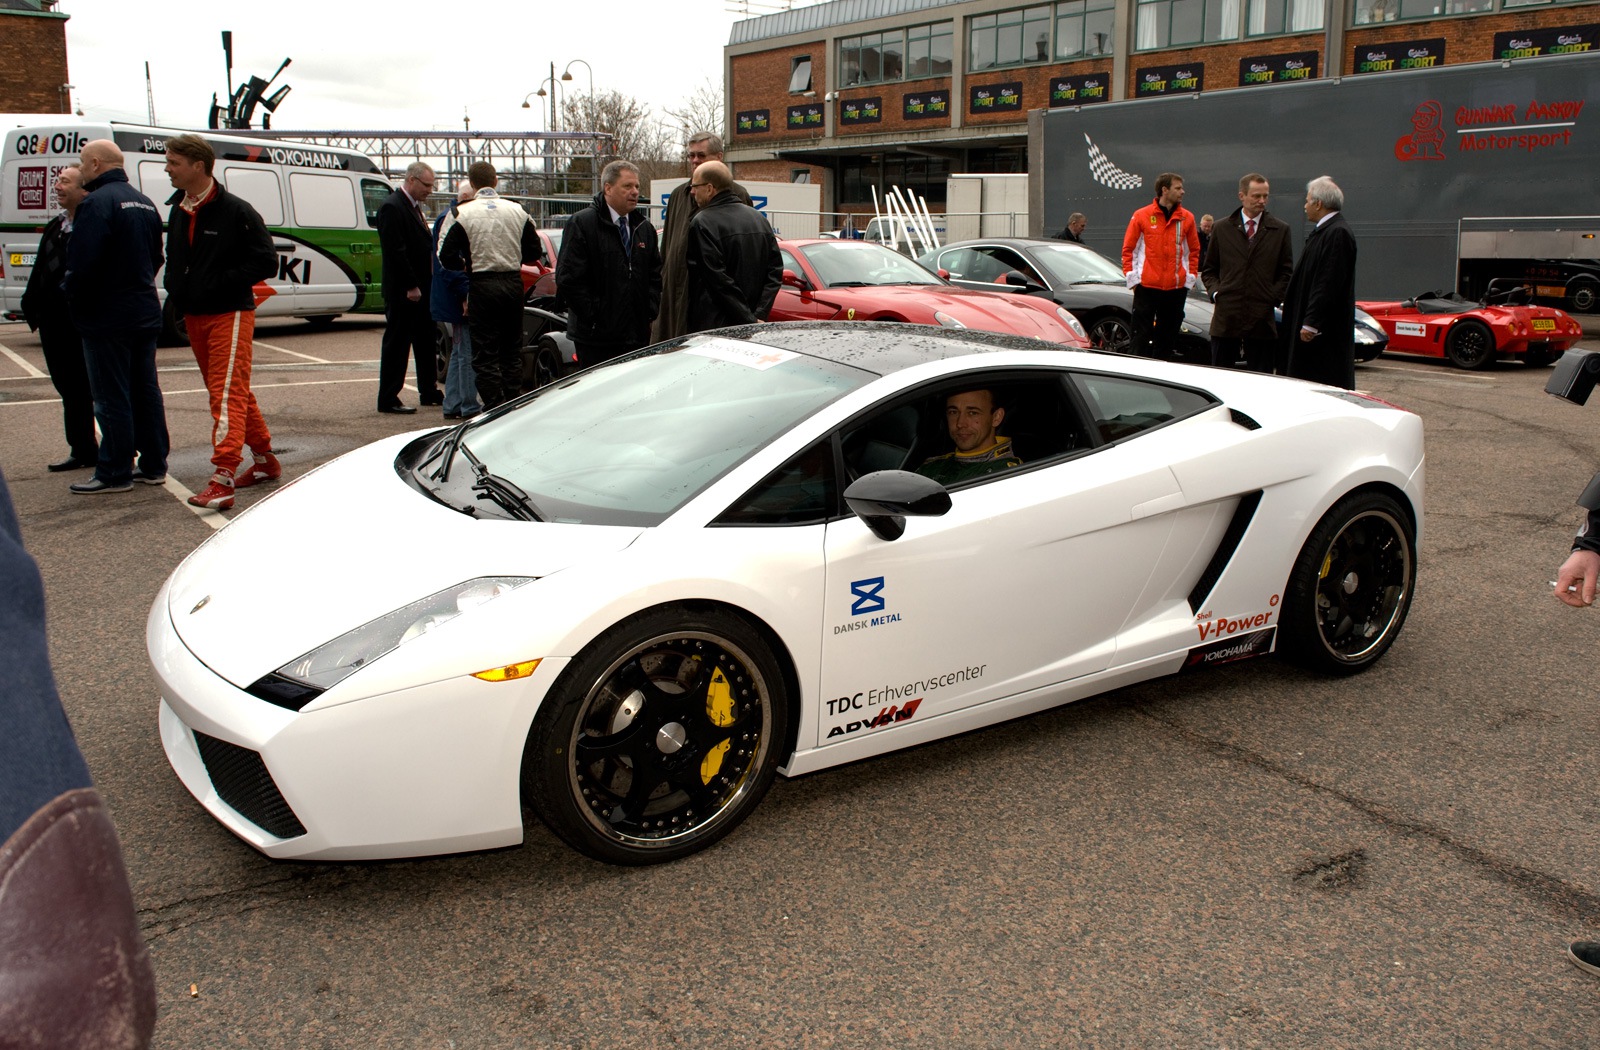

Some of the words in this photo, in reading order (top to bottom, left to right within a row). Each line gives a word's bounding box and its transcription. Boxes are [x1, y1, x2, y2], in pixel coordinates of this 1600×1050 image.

[1360, 60, 1394, 72] SPORT
[1400, 56, 1436, 68] SPORT
[1244, 70, 1274, 82] SPORT
[1280, 67, 1311, 80] SPORT
[1140, 80, 1166, 91] SPORT
[1170, 78, 1198, 89] SPORT
[1054, 89, 1076, 100] SPORT
[1080, 86, 1104, 97] SPORT
[974, 96, 994, 106] SPORT
[998, 94, 1018, 104] SPORT
[1455, 104, 1517, 126] GUNNAR
[1525, 100, 1585, 120] AASKOV
[16, 134, 39, 155] Q8
[51, 131, 88, 154] Oils
[1460, 129, 1572, 152] Motorsport
[266, 148, 342, 169] YOKOHAMA
[1197, 611, 1212, 620] Shell
[834, 620, 868, 635] DANSK
[870, 613, 902, 627] METAL
[1197, 612, 1273, 641] V-Power
[1204, 642, 1253, 662] YOKOHAMA
[826, 692, 864, 716] TDC
[868, 664, 987, 706] Erhvervscenter
[826, 706, 913, 739] ADVAN
